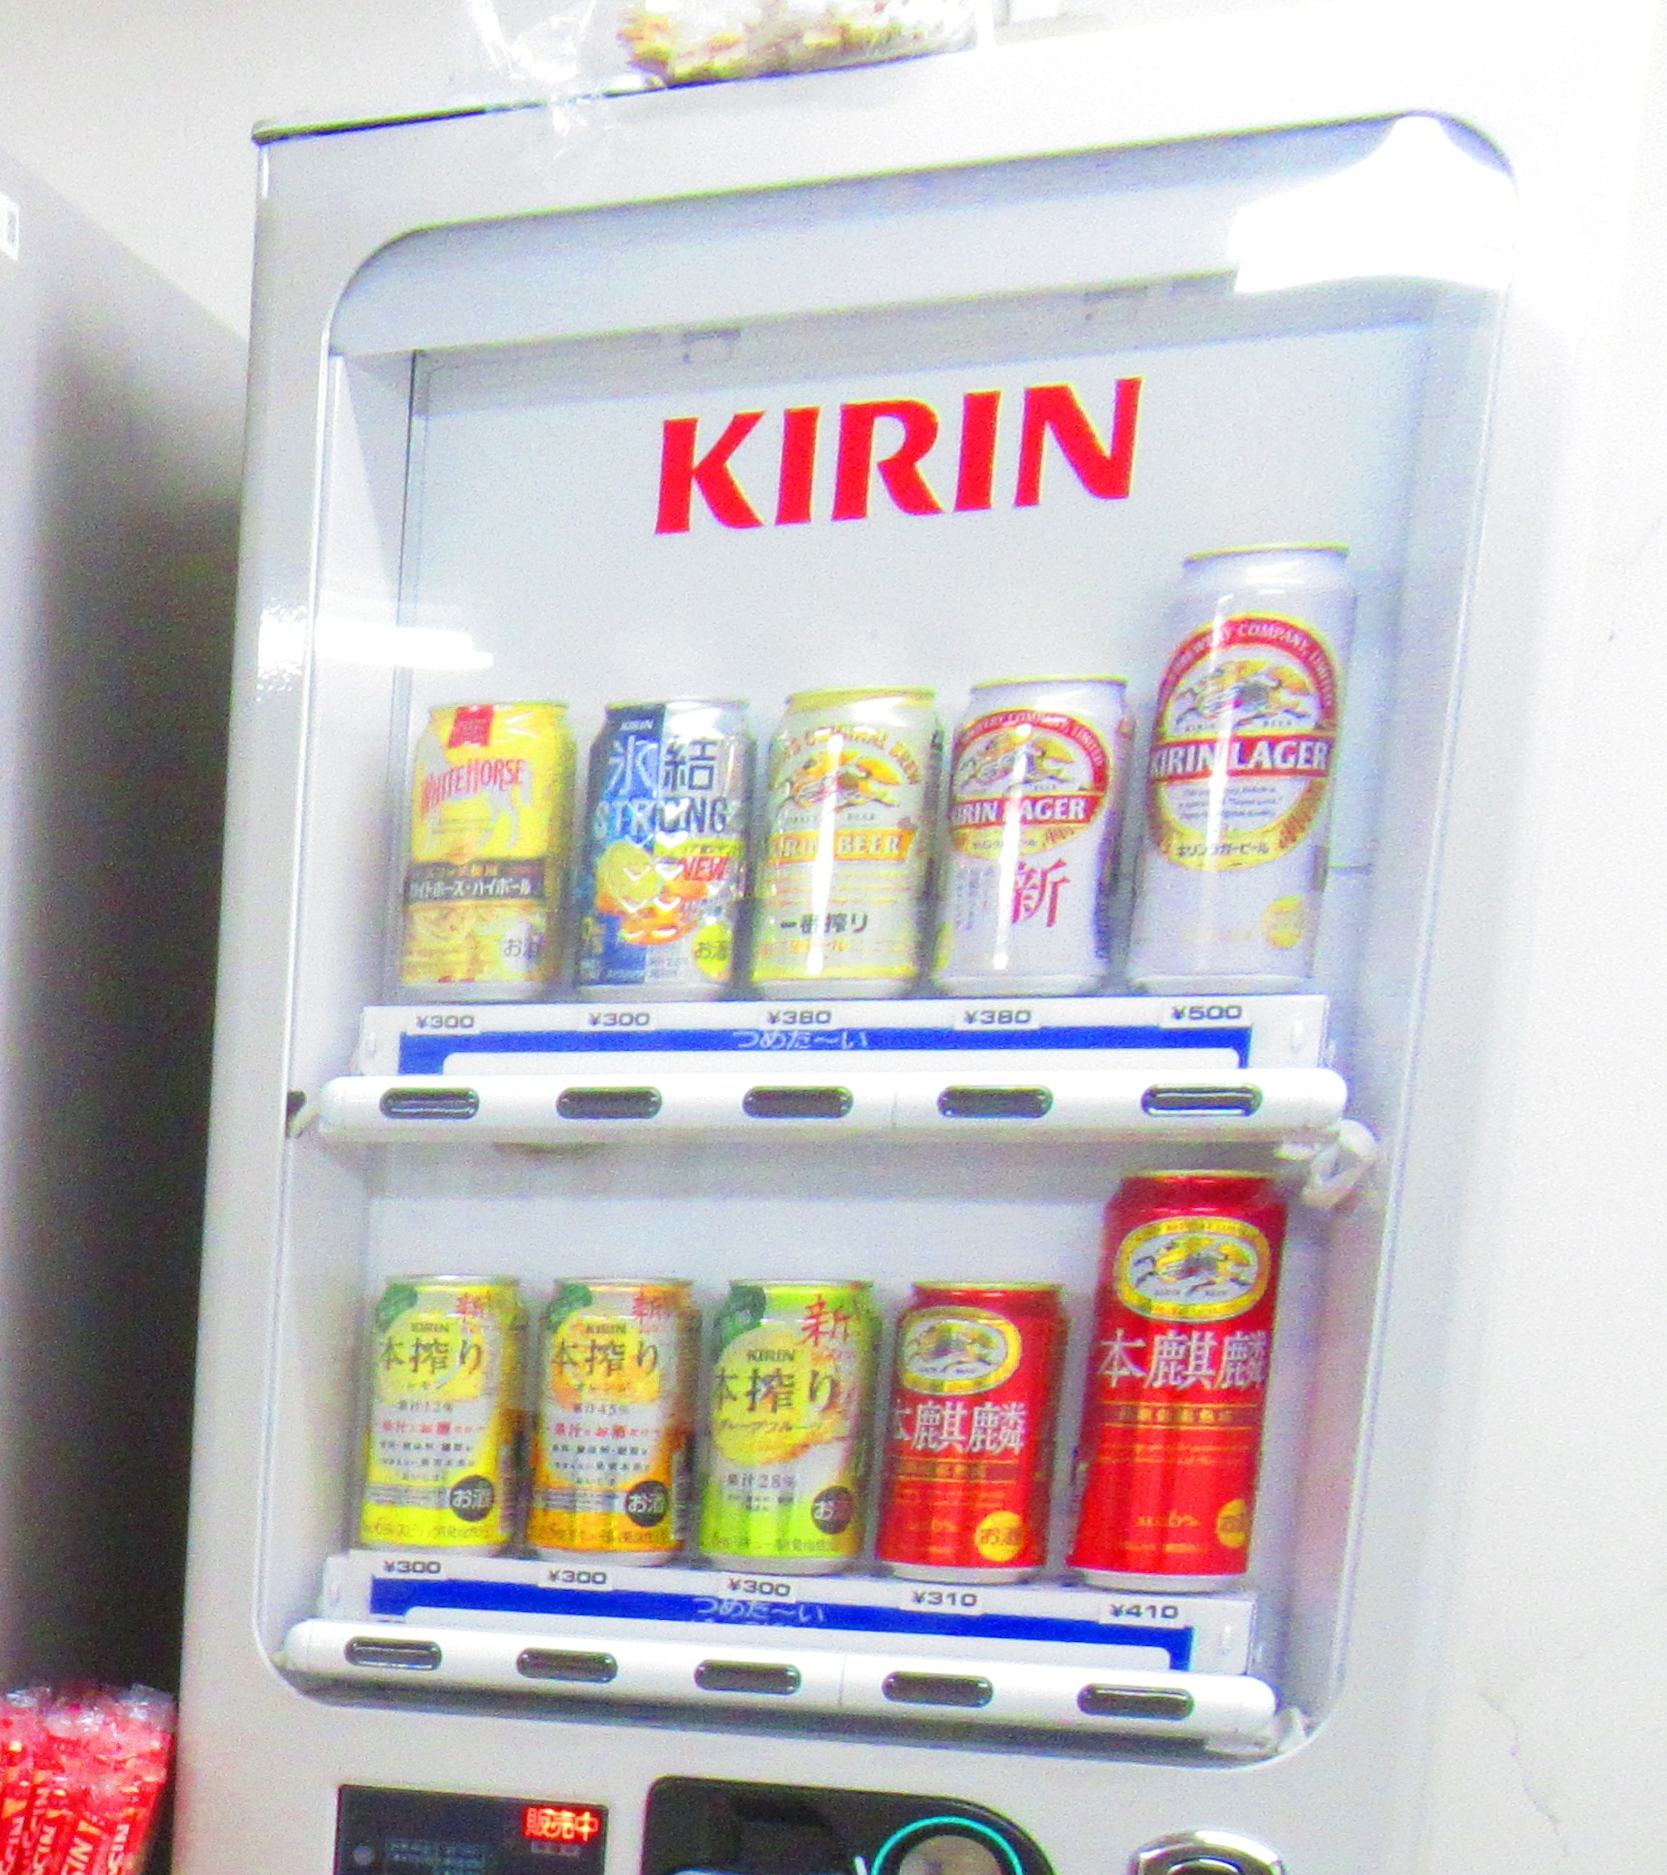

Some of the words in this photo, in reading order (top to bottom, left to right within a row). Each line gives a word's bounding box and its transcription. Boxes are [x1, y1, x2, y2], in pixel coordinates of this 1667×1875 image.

[654, 377, 1143, 535] KIRIN
[1233, 738, 1332, 770] LAGER
[610, 735, 718, 796] 氷結
[594, 797, 728, 840] STRONG
[839, 835, 902, 856] BEER
[1010, 858, 1072, 930] 新
[415, 1013, 475, 1030] ¥300
[588, 1011, 651, 1028] ¥300
[767, 1008, 832, 1026] ¥380
[964, 1007, 1032, 1026] ¥380
[1171, 1004, 1243, 1021] ¥500
[797, 1294, 852, 1347] 新
[380, 1336, 482, 1376] 本搾り
[553, 1337, 659, 1379] 本搾り
[746, 1349, 795, 1362] KIRIN
[1098, 1328, 1268, 1390] 本麒麟
[716, 1366, 841, 1415] 本搾り
[383, 1560, 441, 1576] ¥300
[549, 1570, 607, 1586] ¥300
[727, 1579, 791, 1597] ¥300
[912, 1590, 979, 1607] ¥310
[1109, 1603, 1179, 1619] ¥410
[525, 1807, 599, 1841] 販売中
